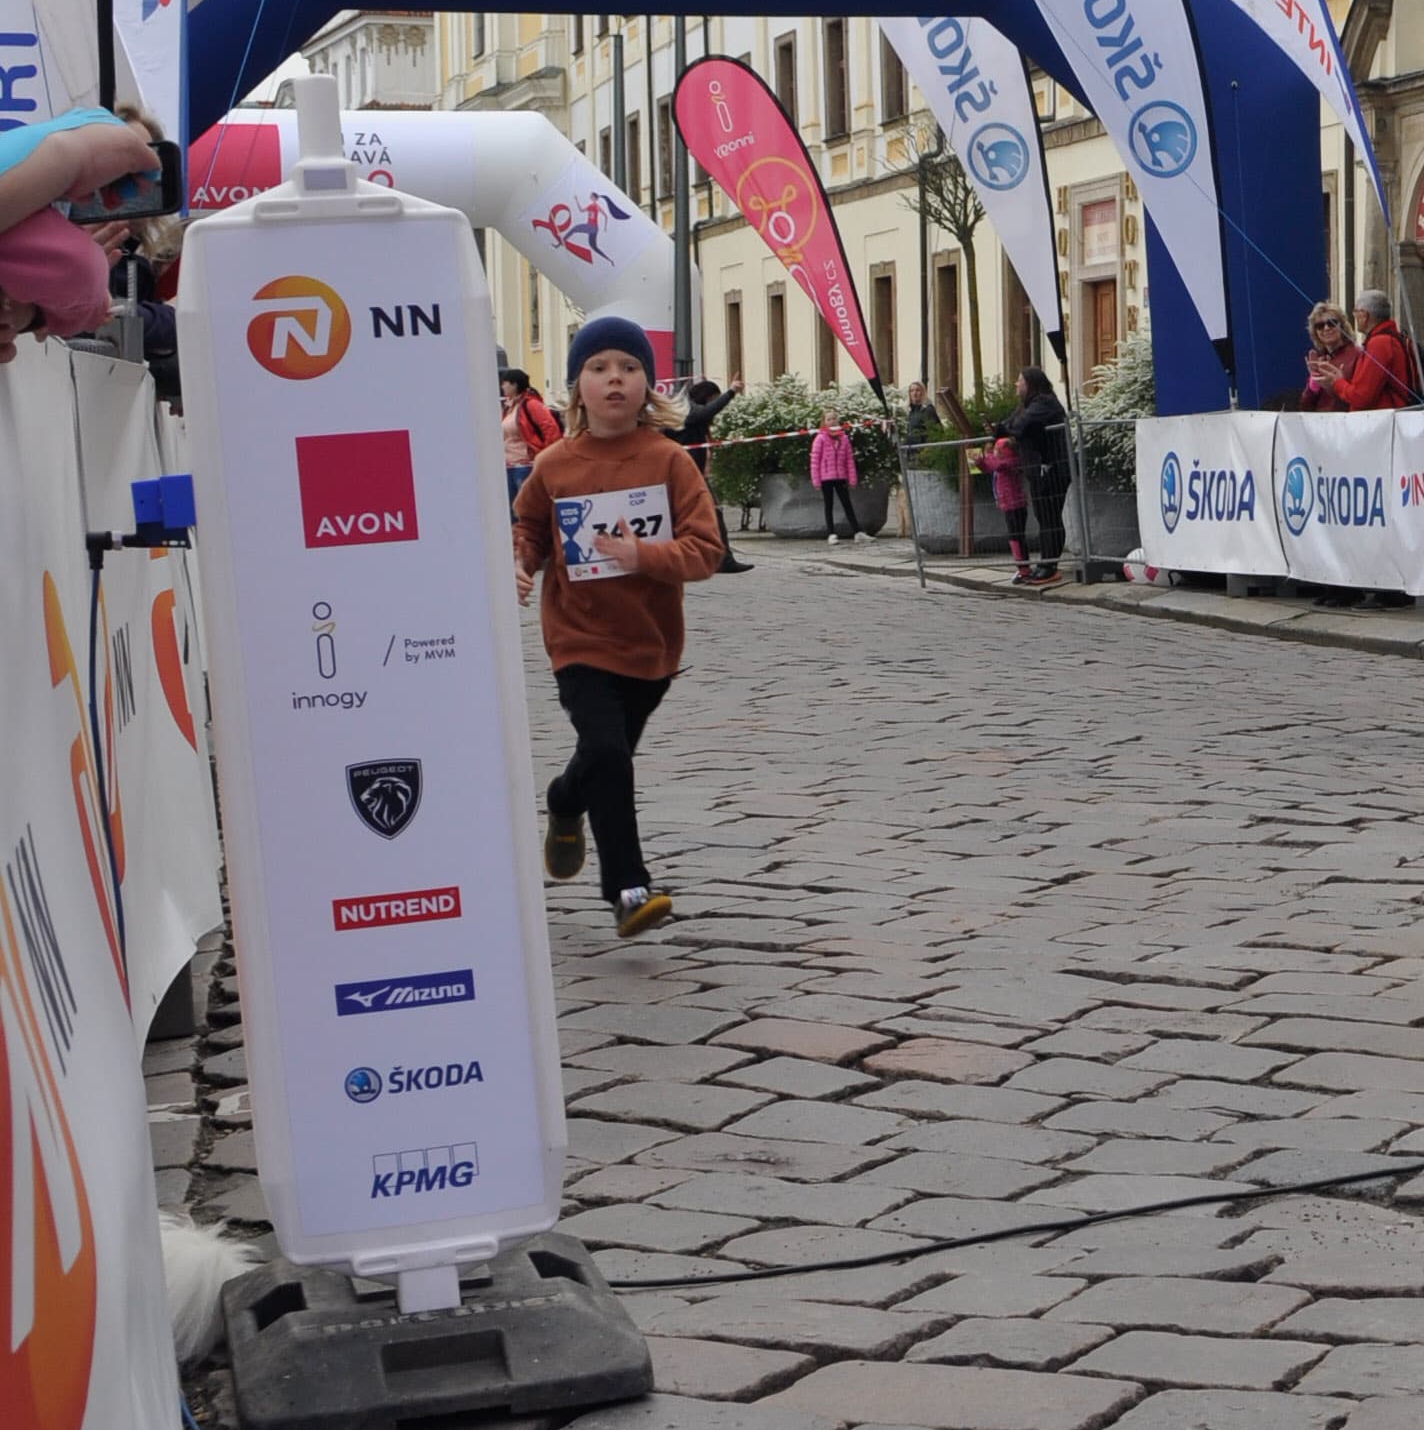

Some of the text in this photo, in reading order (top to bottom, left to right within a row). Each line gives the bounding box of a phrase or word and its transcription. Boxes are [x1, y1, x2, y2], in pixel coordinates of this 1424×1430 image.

[369, 303, 442, 338] NN
[1186, 459, 1255, 521] ŠKODA
[1317, 466, 1386, 527] ŠKODA
[316, 510, 405, 538] AVON
[404, 635, 455, 648] Powered
[405, 649, 455, 664] by MVM
[292, 691, 367, 710] innogy
[340, 894, 455, 923] NUTREND
[388, 1061, 484, 1094] ŠKODA
[370, 1161, 475, 1199] KPMG
